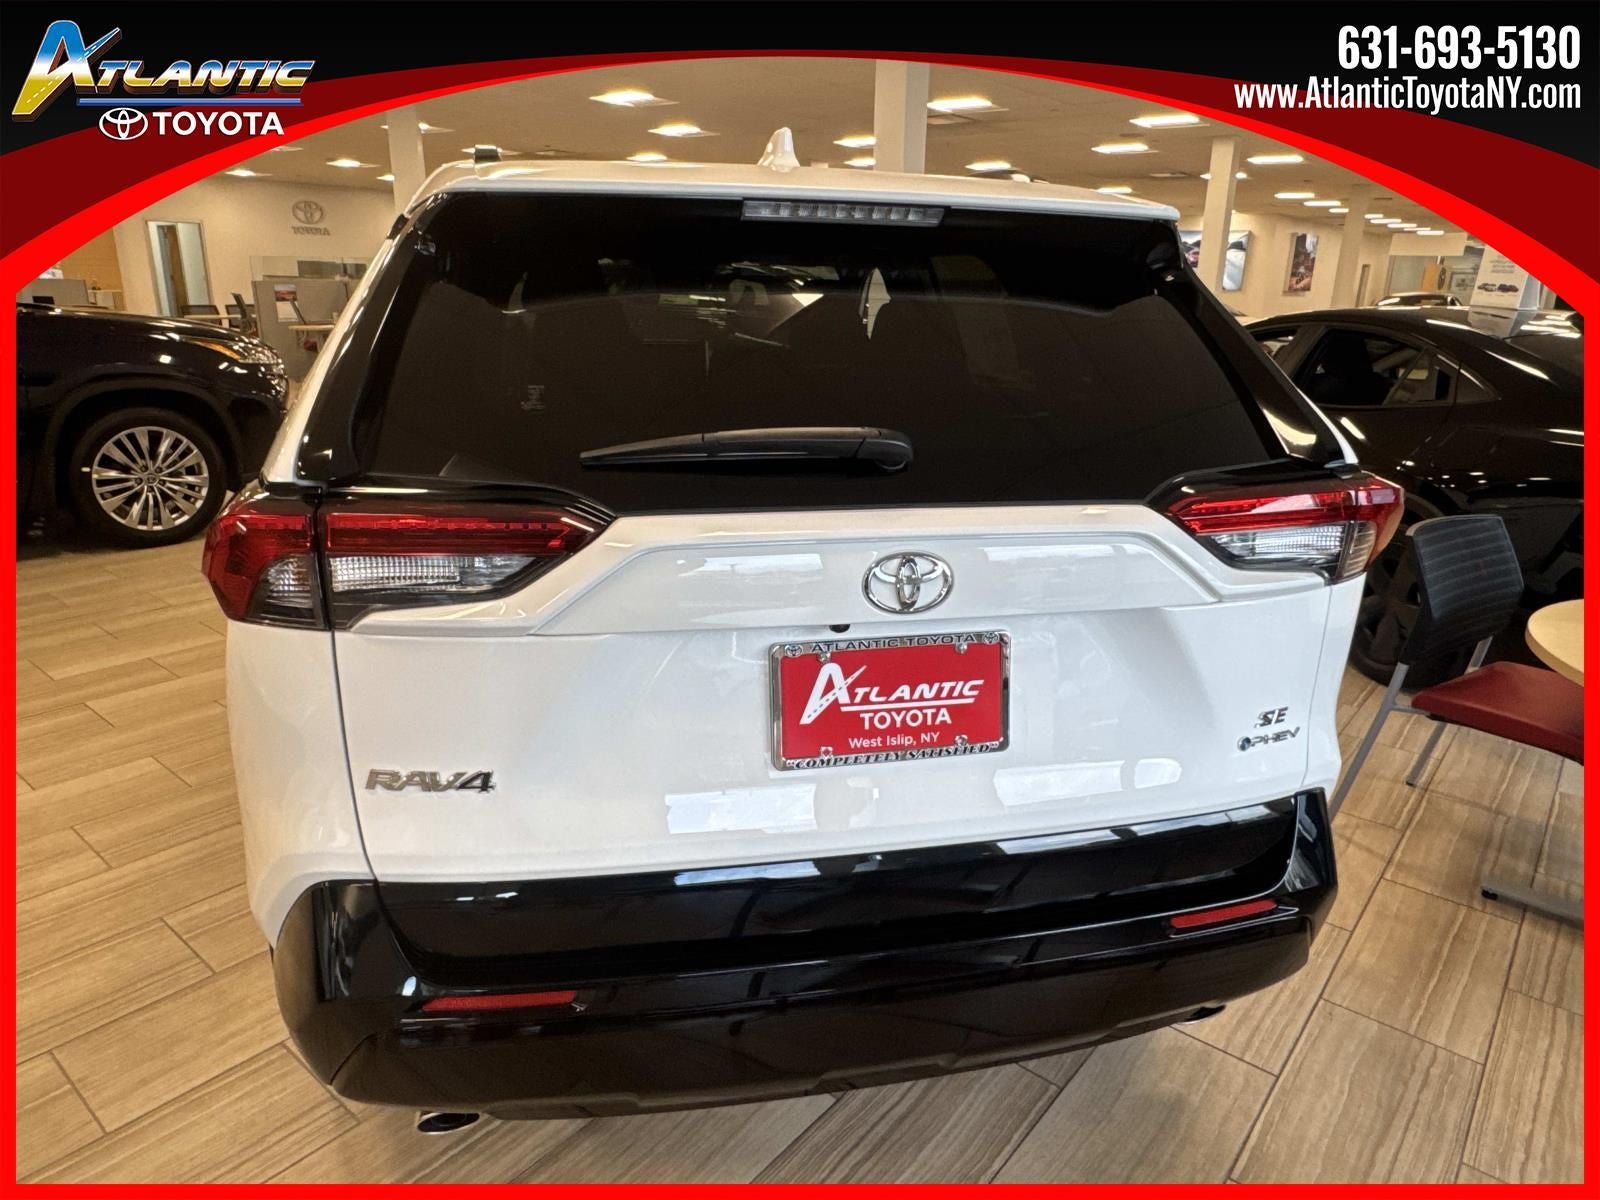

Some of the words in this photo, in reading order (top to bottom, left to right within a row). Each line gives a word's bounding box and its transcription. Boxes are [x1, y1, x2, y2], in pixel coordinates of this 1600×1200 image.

[291, 226, 331, 236] TOYOTA
[811, 638, 899, 653] ATLANTIC
[907, 634, 976, 647] TOYOTA
[799, 662, 985, 725] ATLANTIC
[860, 707, 952, 731] TOYOTA
[1254, 706, 1289, 728] SE
[848, 736, 883, 749] West
[886, 733, 917, 747] Islip,
[920, 731, 940, 744] NY
[1250, 726, 1300, 747] PHEV
[365, 769, 496, 793] RAV4
